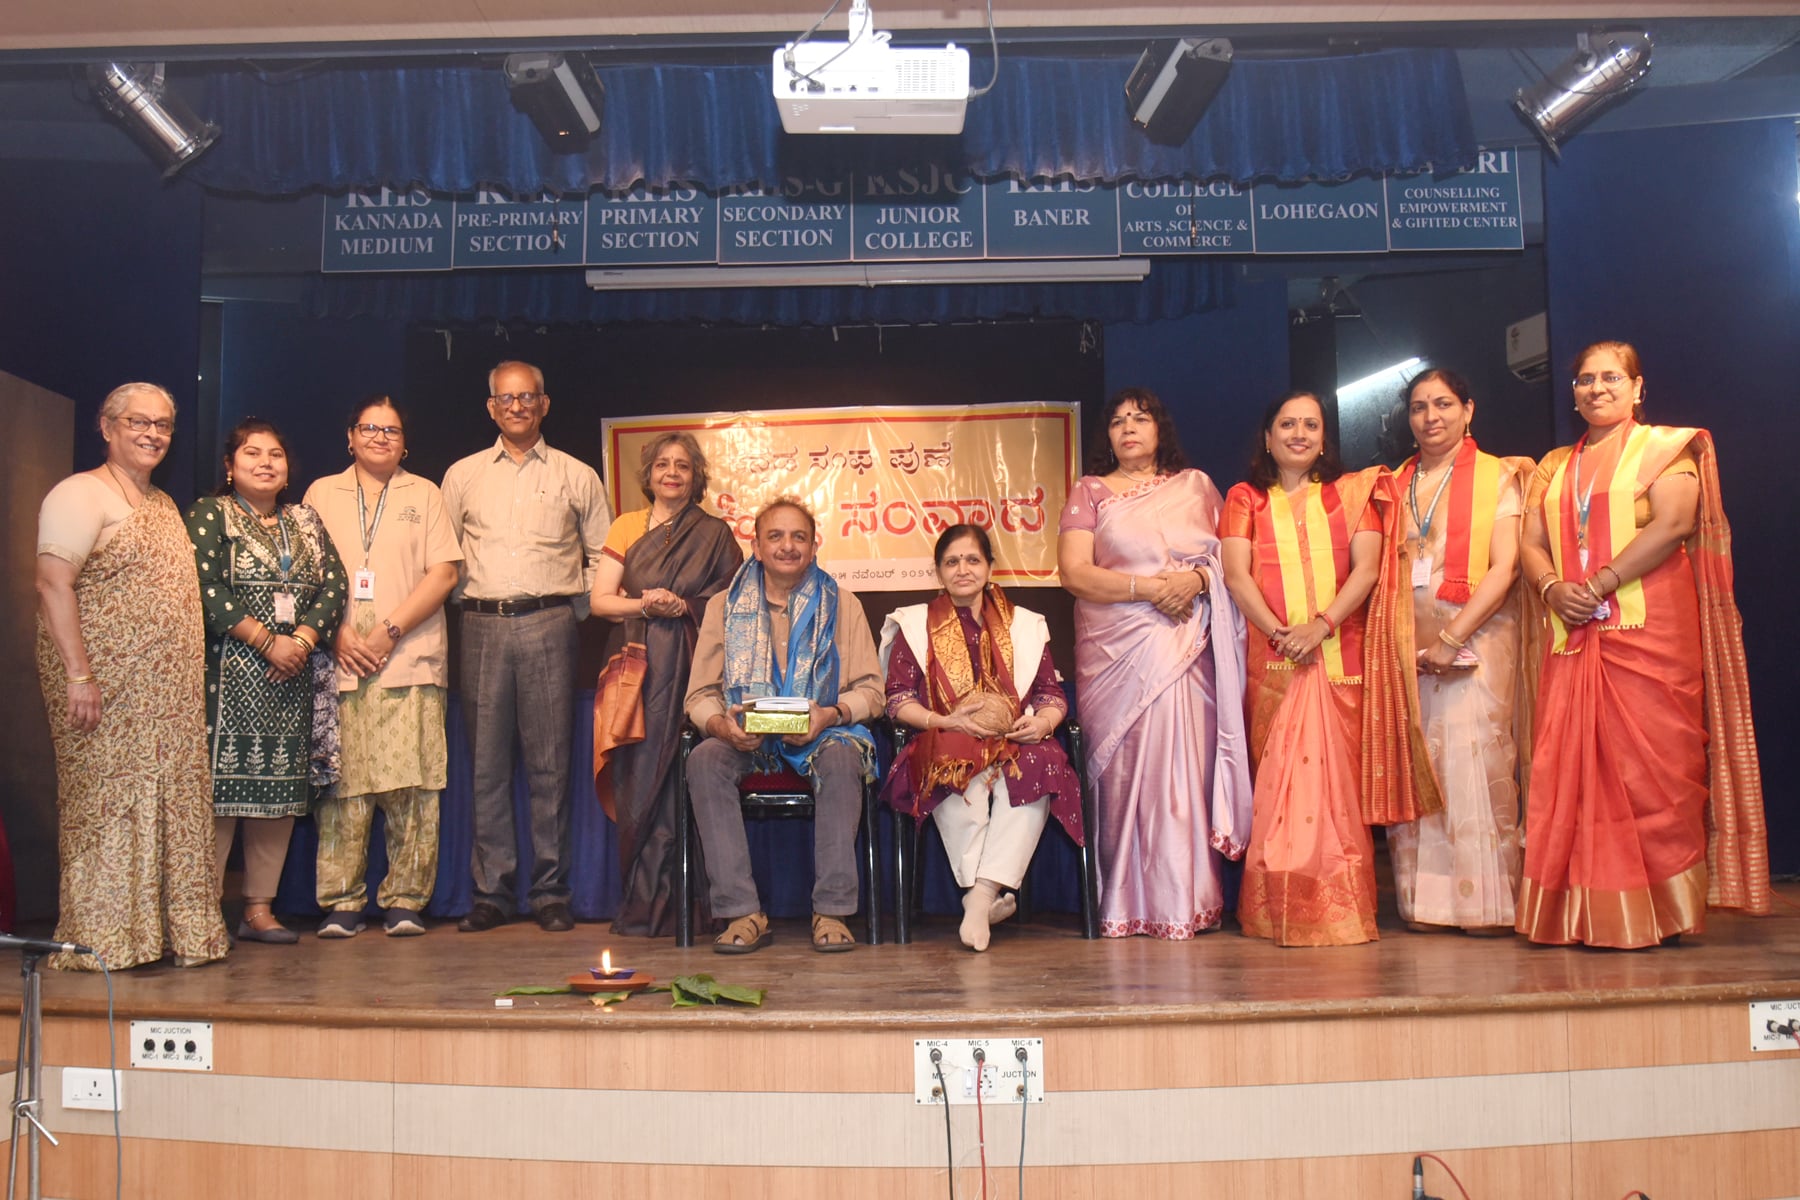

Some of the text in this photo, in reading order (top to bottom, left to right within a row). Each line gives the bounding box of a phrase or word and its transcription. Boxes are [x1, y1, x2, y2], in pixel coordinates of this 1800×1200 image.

[1404, 187, 1500, 200] COUNSELLING
[600, 207, 704, 226] PRIMARY
[723, 205, 846, 223] SECONDARY
[876, 206, 961, 225] JUNIOR
[1013, 208, 1091, 227] BANER
[1260, 202, 1379, 221] LOHEGAON
[1399, 202, 1508, 215] EMPOWERMENT
[335, 212, 443, 231] KANNADA
[457, 210, 583, 228] PRE-PRIMARY
[1124, 220, 1163, 233] ARTS
[1236, 219, 1249, 232] &
[1391, 216, 1518, 229] & GIFITED CENTER
[341, 236, 434, 255] MEDIUM
[470, 234, 567, 252] SECTION
[601, 231, 700, 249] SECTION
[735, 229, 833, 248] SECTION
[865, 231, 973, 250] COLLEGE
[1142, 235, 1232, 249] COMMERCE
[808, 444, 874, 475] ಸಂಘ
[840, 486, 1046, 537] ಸಂವಾದ
